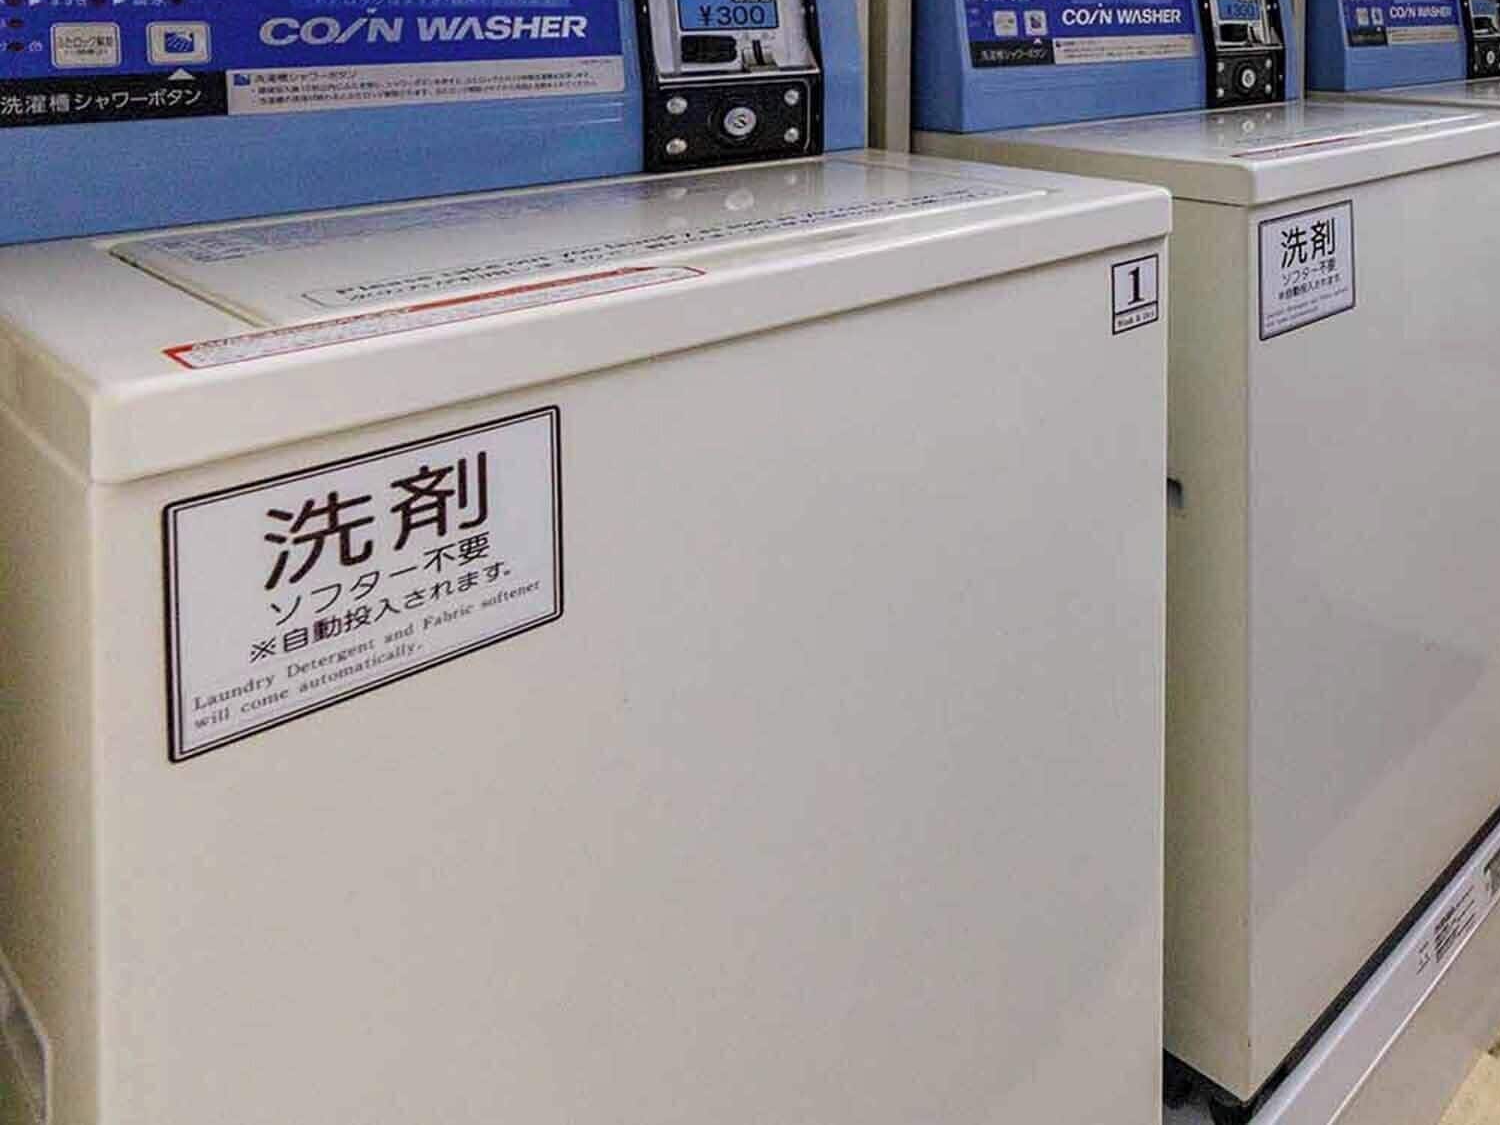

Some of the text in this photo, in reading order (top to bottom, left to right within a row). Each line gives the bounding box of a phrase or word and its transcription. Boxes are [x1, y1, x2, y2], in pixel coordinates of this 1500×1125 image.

[258, 5, 588, 47] COIN WASHER
[700, 4, 766, 27] ¥300
[1062, 2, 1181, 27] COIN WASHER
[0, 88, 202, 117] 洗濯槽シャワーボタン
[1280, 217, 1337, 269] 洗剤
[1127, 266, 1146, 305] 1
[263, 450, 488, 592] 洗剤
[270, 531, 490, 626] ソフター不要
[193, 579, 541, 710] Laundry Detergent and Fabric softener
[193, 643, 425, 730] will come automatically.
